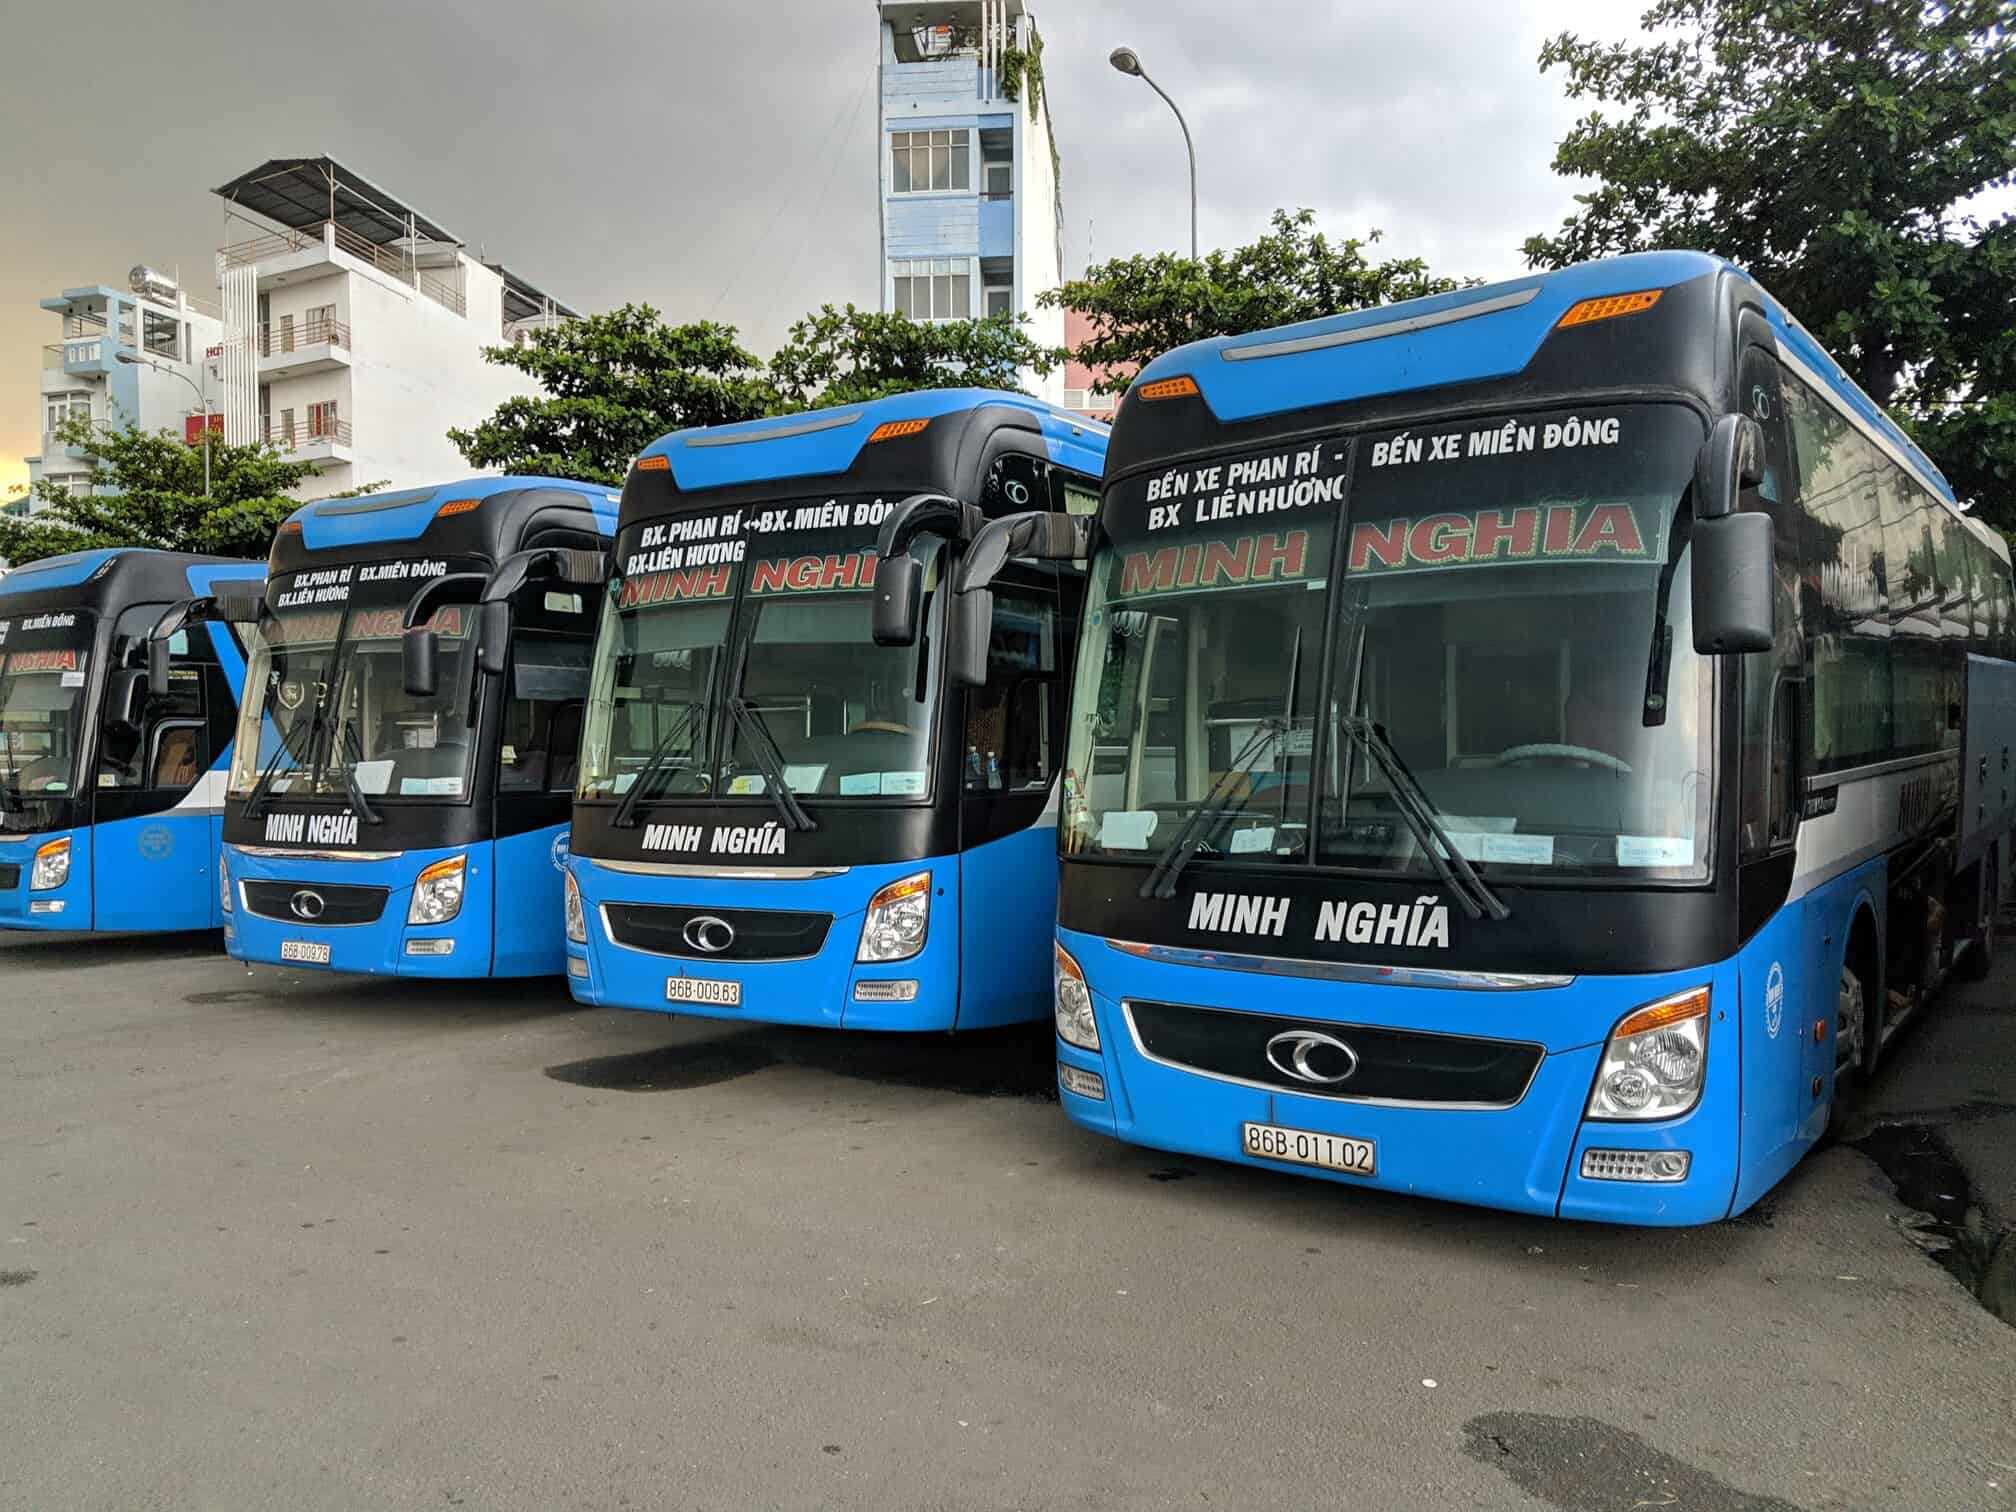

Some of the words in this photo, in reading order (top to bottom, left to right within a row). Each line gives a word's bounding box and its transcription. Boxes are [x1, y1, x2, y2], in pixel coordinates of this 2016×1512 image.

[1371, 431, 1421, 467] BẾN
[1428, 433, 1461, 462] XE
[1468, 419, 1536, 457] MIỀN
[1543, 416, 1620, 449] ĐÔNG
[1147, 468, 1189, 501] BẾN
[1192, 466, 1222, 493] XE
[1227, 454, 1289, 487] PHAN
[1294, 443, 1323, 476] RÍ
[720, 509, 744, 537] RÍ
[853, 499, 899, 527] ĐÔ
[1148, 502, 1183, 530] BX
[338, 565, 354, 583] RÍ
[411, 560, 447, 577] ĐÔNG
[1119, 529, 1309, 596] MINH
[619, 565, 731, 609] MINH
[264, 813, 305, 842] MINH
[307, 809, 359, 845] NGHĨA
[641, 824, 703, 852] MINH
[710, 821, 786, 855] NGHĨA
[1187, 892, 1291, 937] MINH
[1314, 895, 1449, 948] NGHĨA
[669, 979, 738, 1002] 86B-009.63
[1248, 1127, 1370, 1171] 86B-011.02
